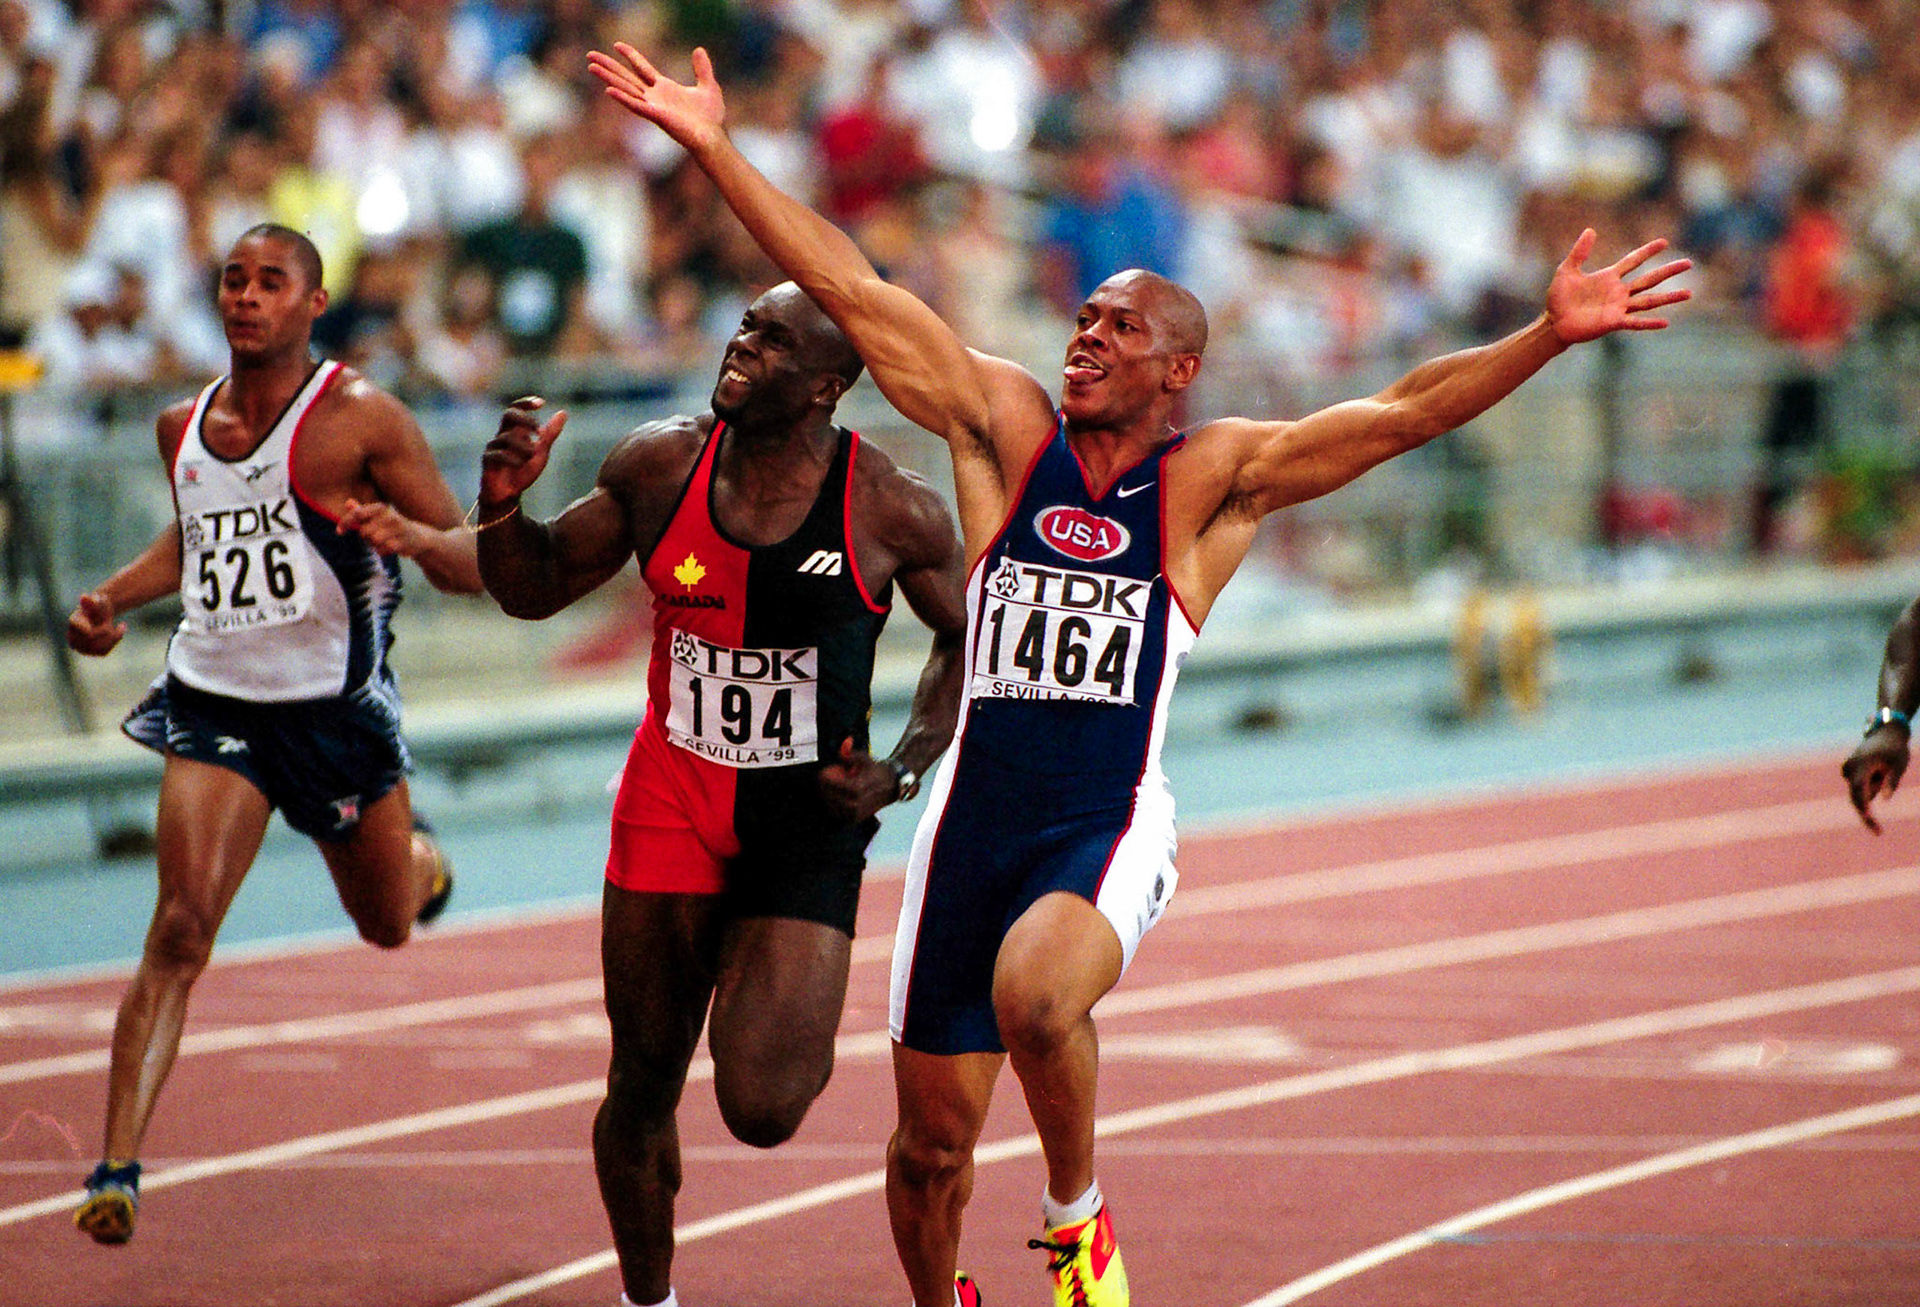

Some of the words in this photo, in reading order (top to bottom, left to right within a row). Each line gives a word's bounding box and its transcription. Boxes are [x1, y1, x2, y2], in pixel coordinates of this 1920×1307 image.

[202, 500, 295, 541] TDK
[1050, 515, 1111, 550] USA
[199, 541, 295, 611] 526
[1022, 567, 1144, 617] TDK
[697, 639, 811, 682] TDK
[988, 603, 1132, 697] 1464
[689, 676, 792, 747] 194
[684, 738, 760, 763] SEVILLA
[768, 748, 795, 761] '99
